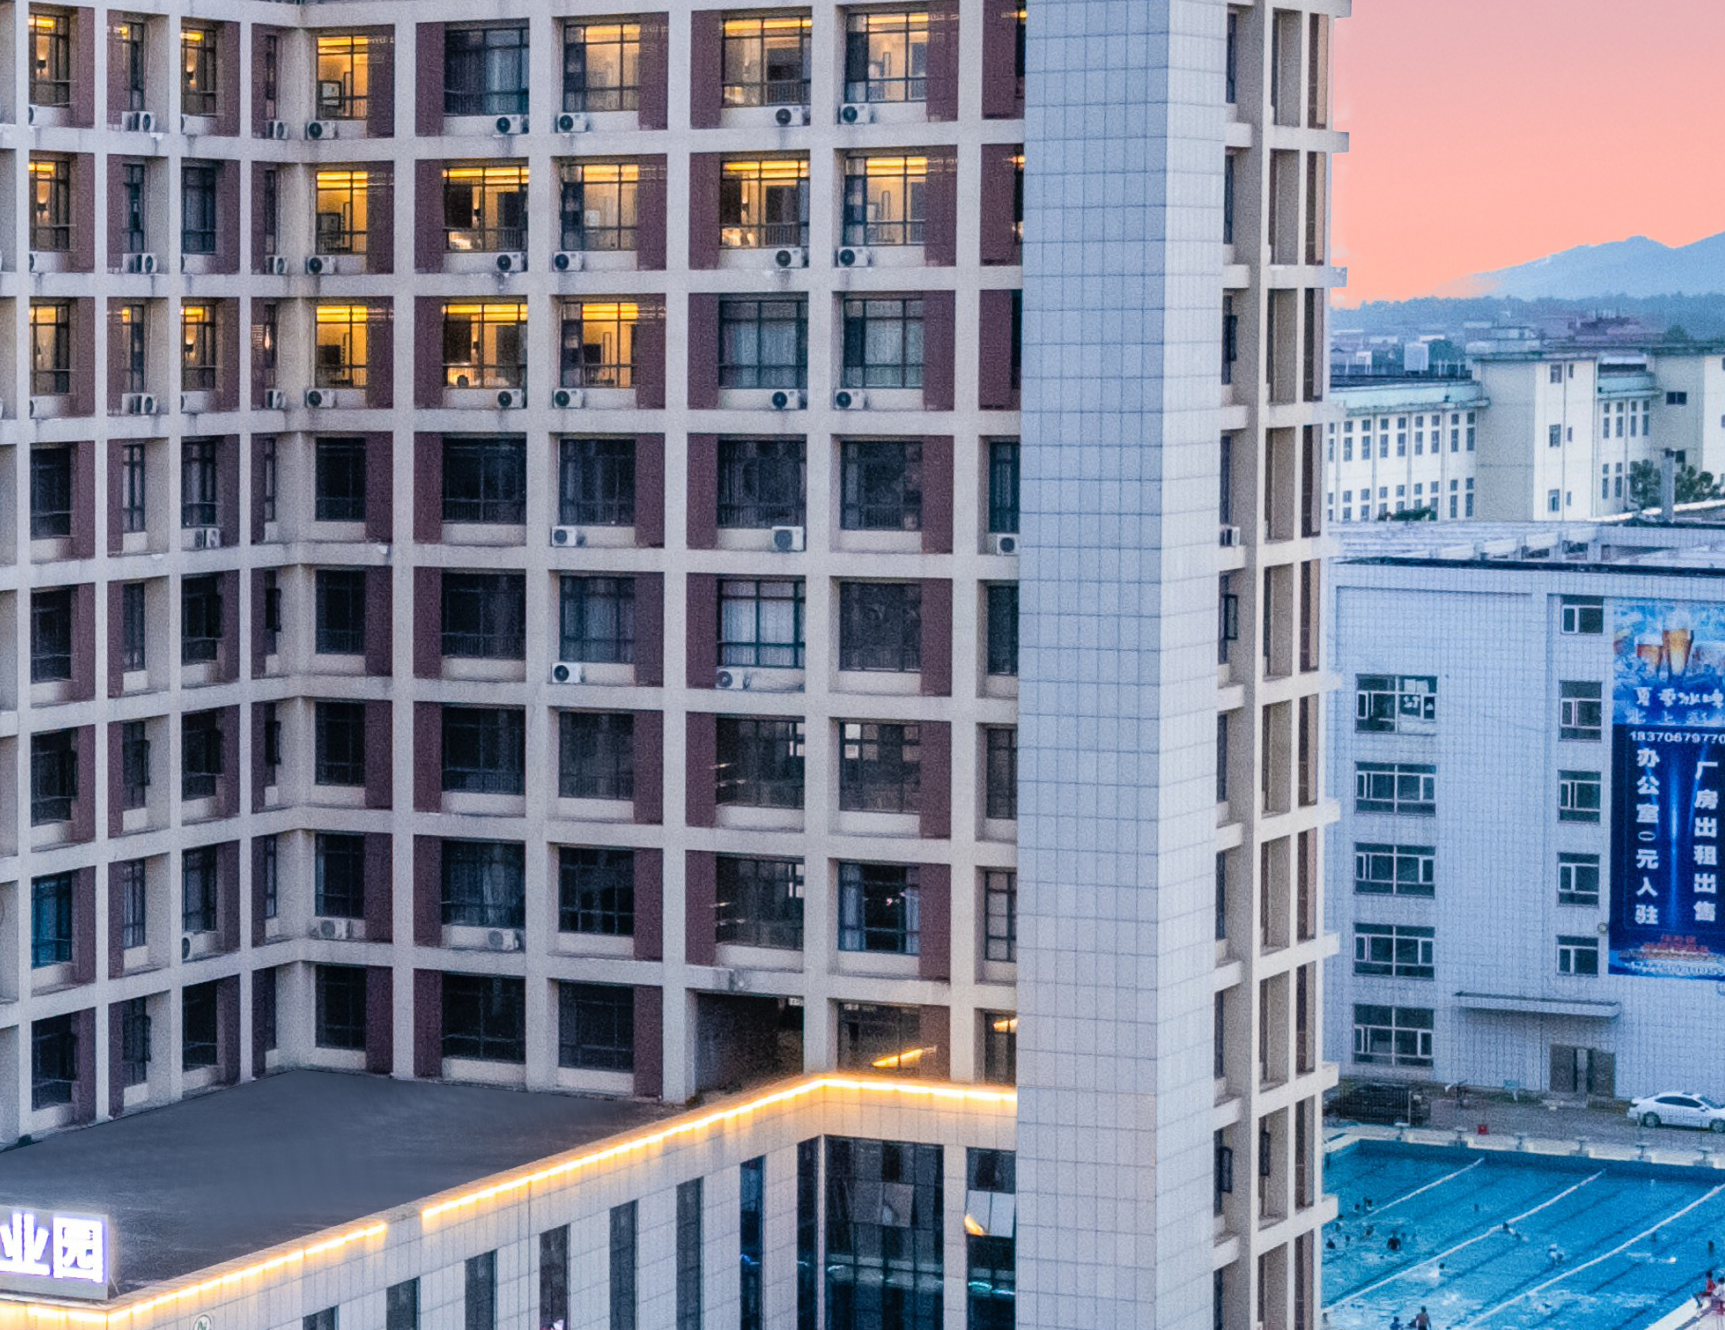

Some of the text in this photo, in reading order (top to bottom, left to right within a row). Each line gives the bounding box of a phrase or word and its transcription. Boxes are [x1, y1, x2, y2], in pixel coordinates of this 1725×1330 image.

[1693, 760, 1719, 923] 厂房出租出售
